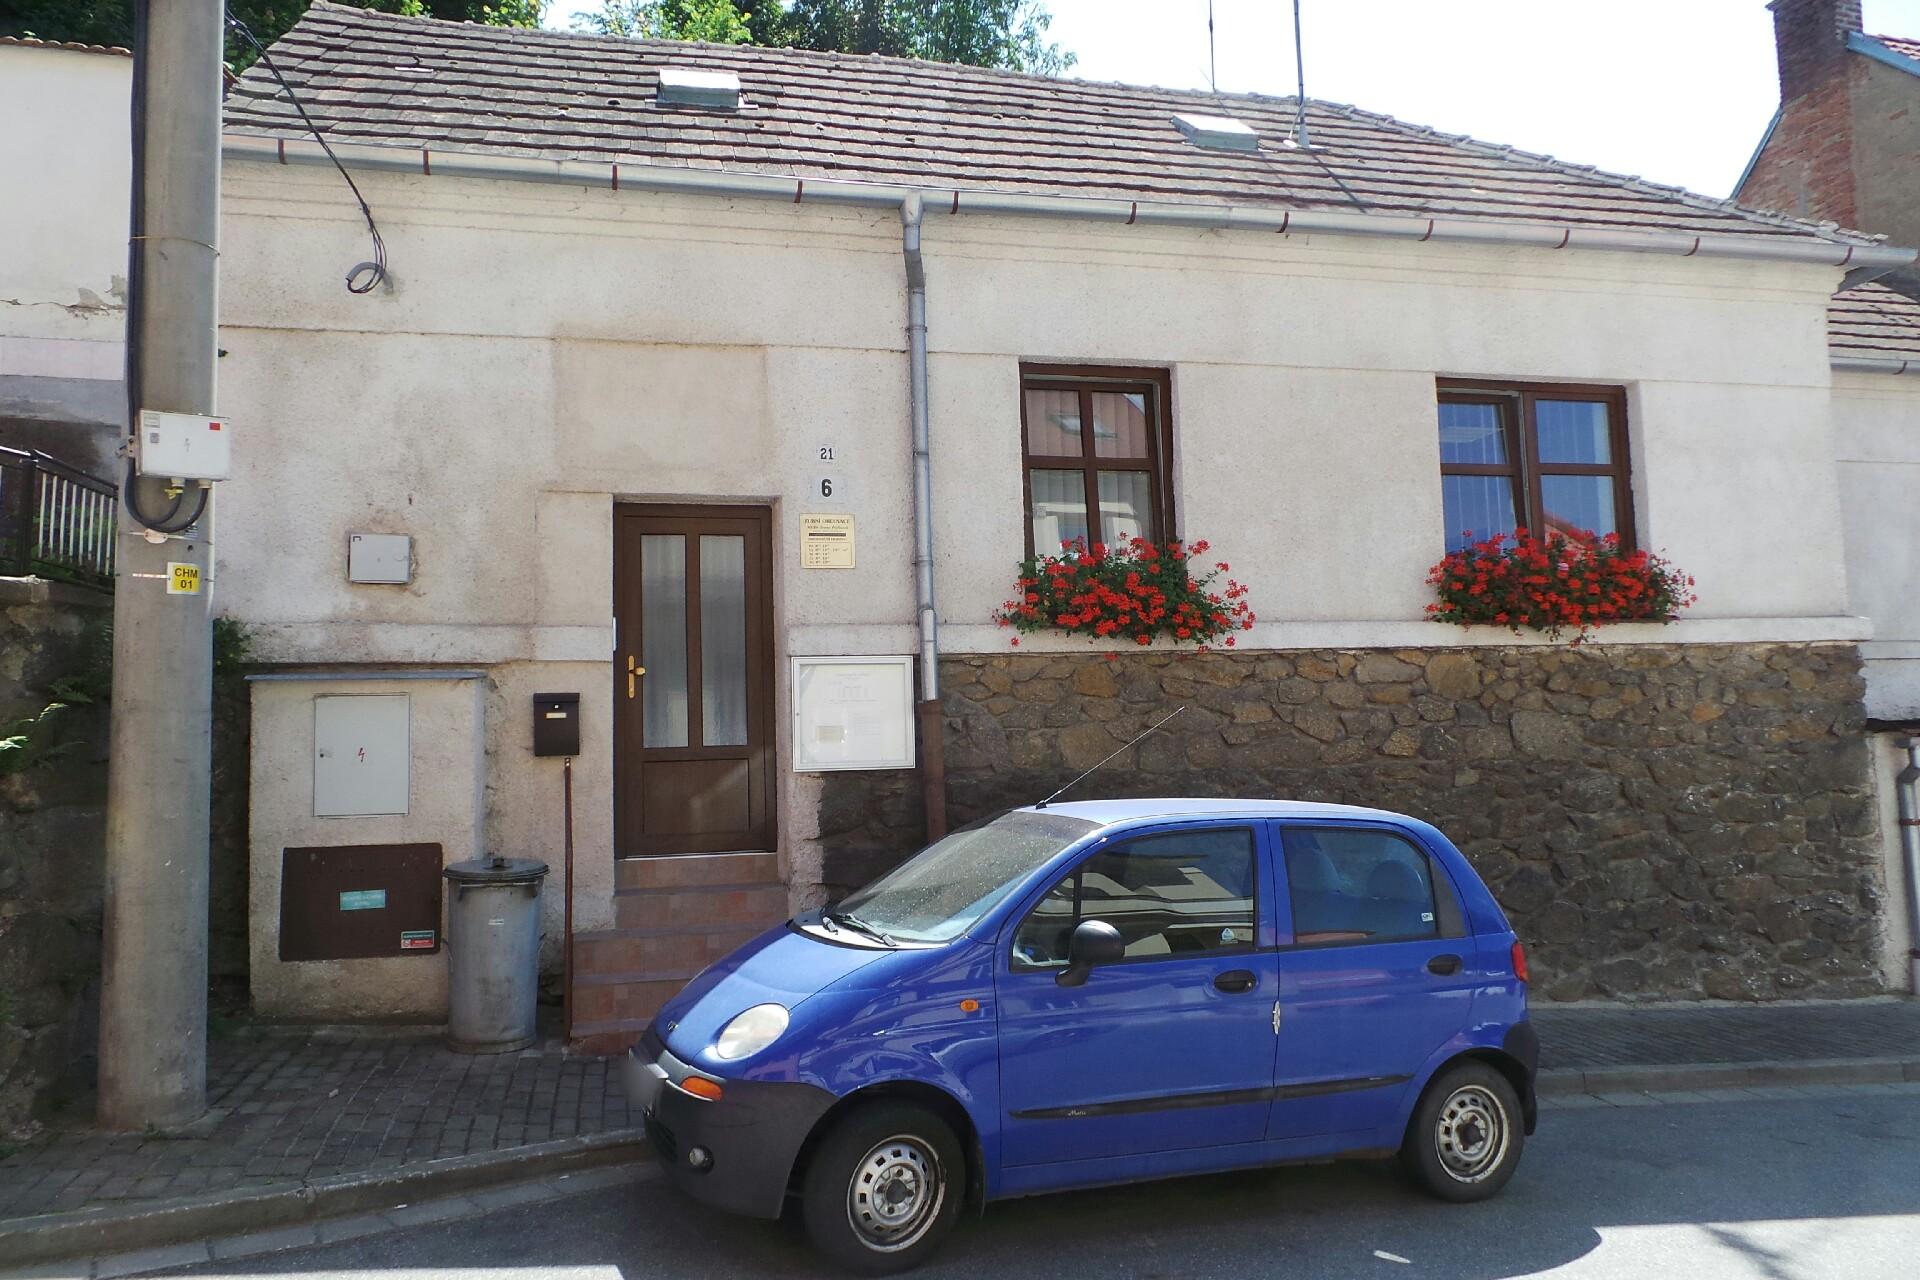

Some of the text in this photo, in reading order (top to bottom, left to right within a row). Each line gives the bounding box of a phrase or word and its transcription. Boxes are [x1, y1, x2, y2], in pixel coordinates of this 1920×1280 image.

[820, 447, 834, 460] 21
[821, 478, 832, 497] 6
[174, 567, 198, 579] CHM
[180, 579, 193, 589] 01
